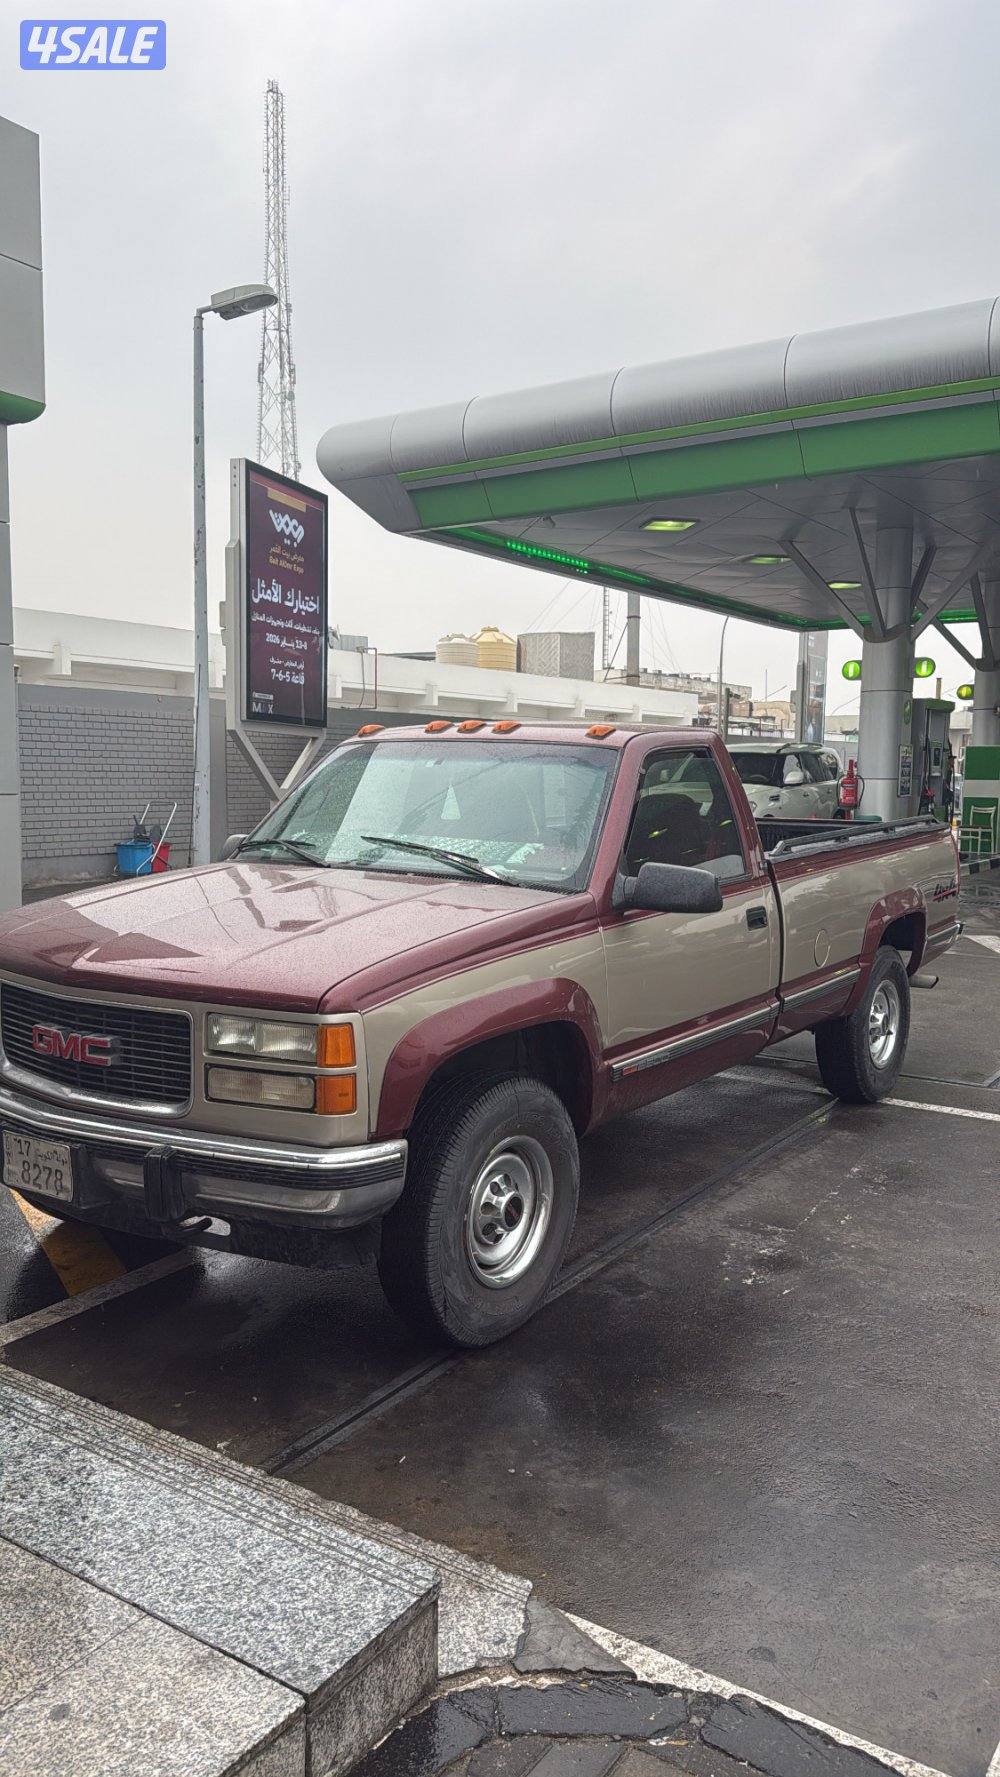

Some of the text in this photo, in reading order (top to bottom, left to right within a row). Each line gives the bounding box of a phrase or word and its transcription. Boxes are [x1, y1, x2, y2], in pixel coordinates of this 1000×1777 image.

[251, 578, 320, 616] اختيارك الأمثل
[265, 632, 281, 644] 2026
[280, 637, 295, 650] يناير
[290, 672, 305, 685] قاعة
[32, 1024, 113, 1067] GMC
[15, 1138, 31, 1156] 17
[21, 1159, 63, 1193] 8278
